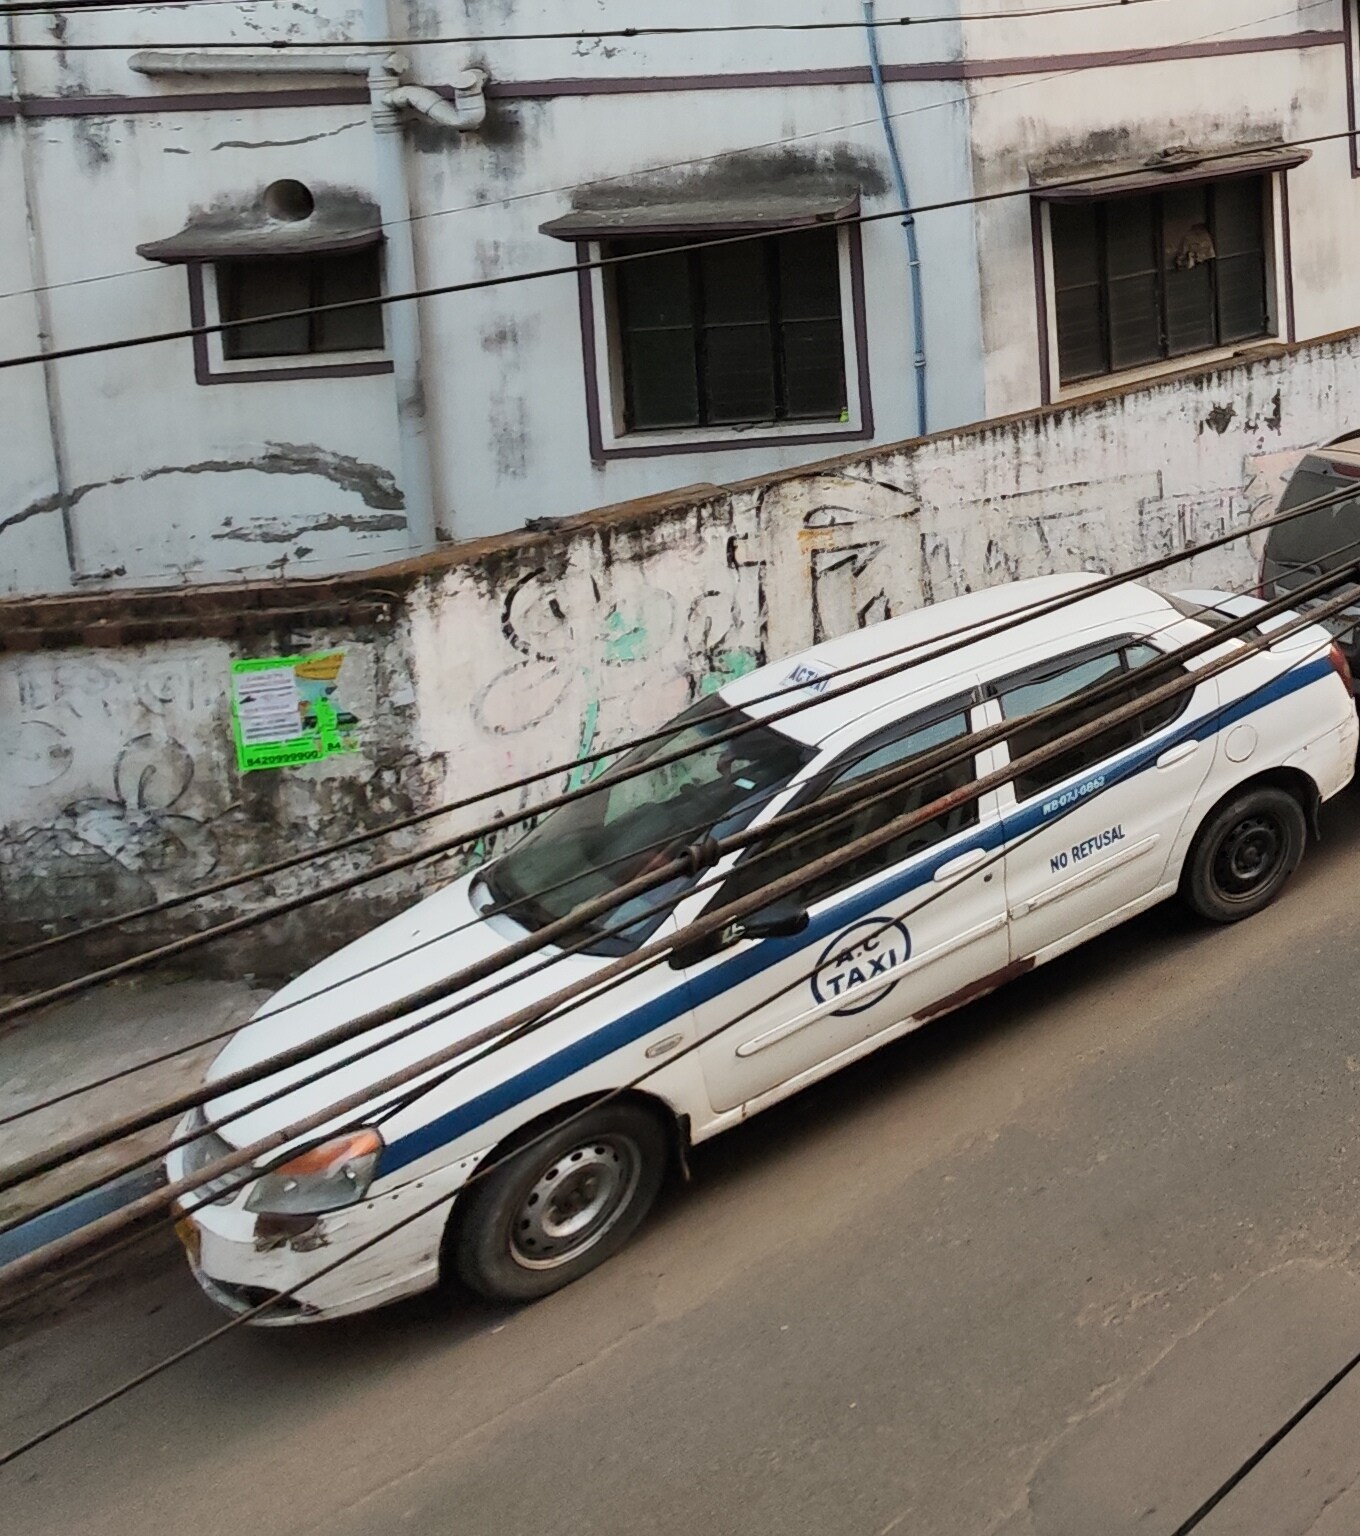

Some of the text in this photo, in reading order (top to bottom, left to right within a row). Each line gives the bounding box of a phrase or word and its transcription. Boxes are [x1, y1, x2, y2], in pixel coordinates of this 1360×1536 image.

[1050, 824, 1126, 874] NO REFUSAL
[826, 948, 897, 996] TAXI
